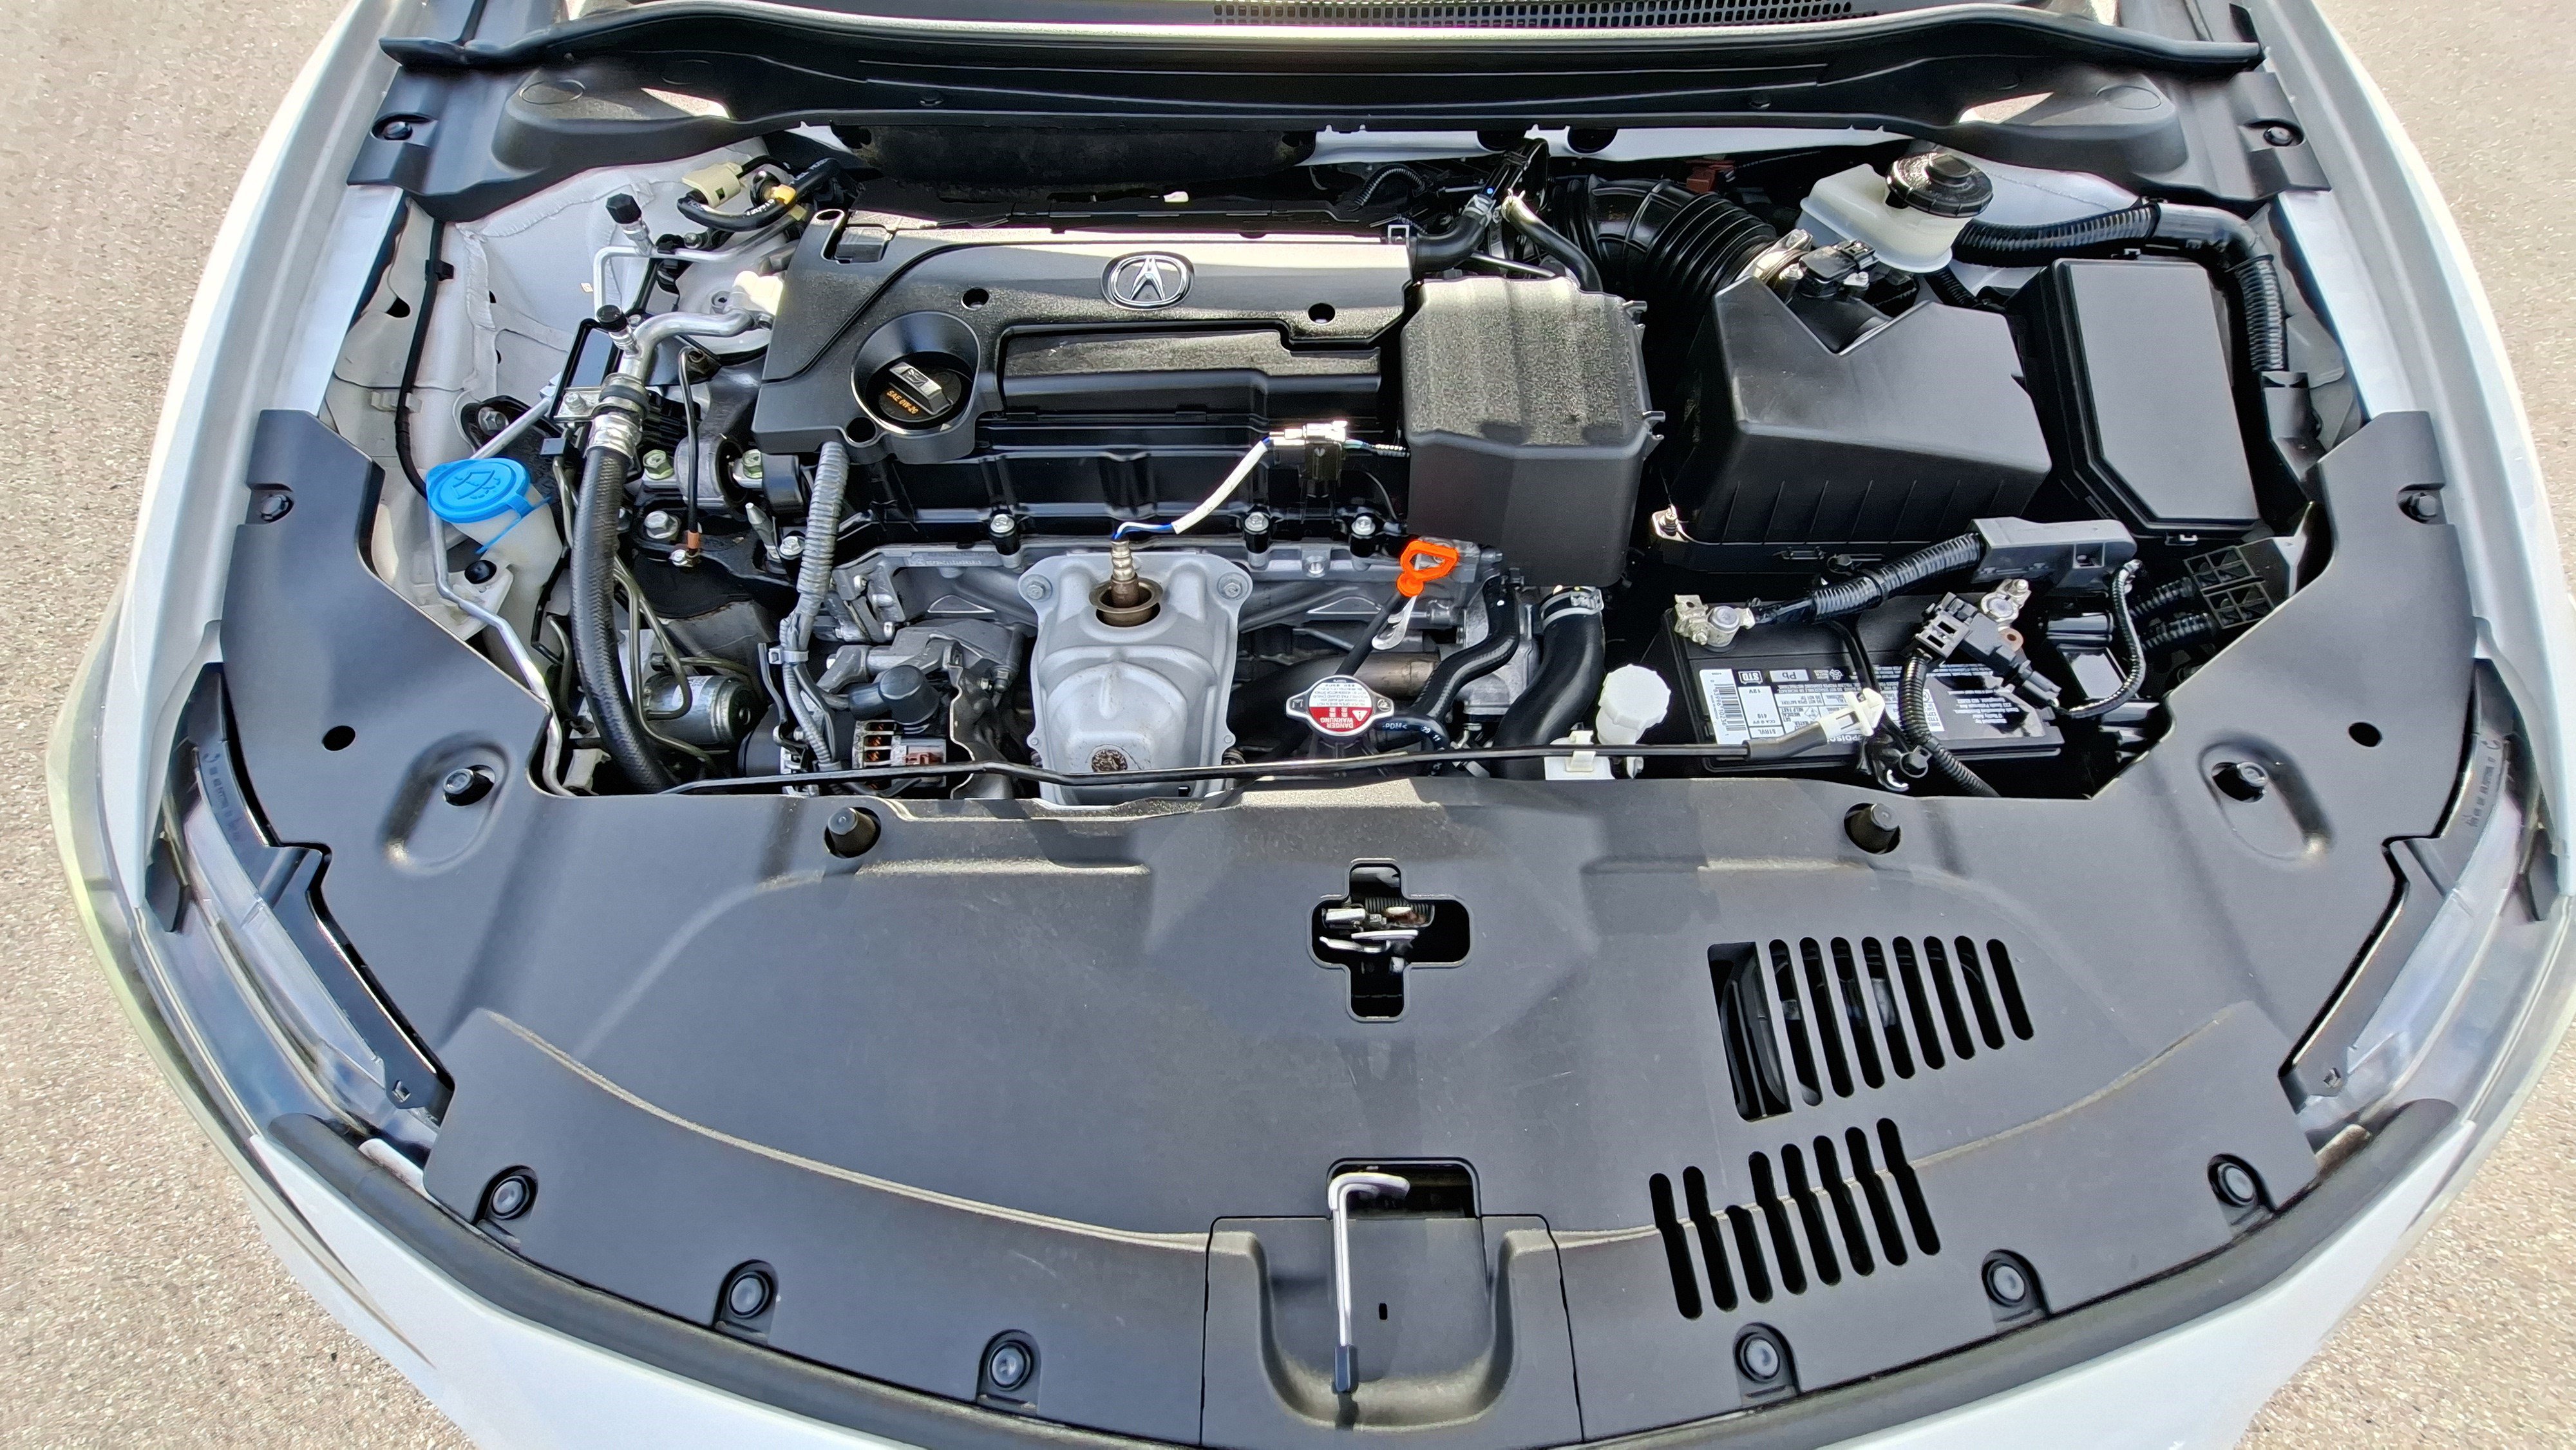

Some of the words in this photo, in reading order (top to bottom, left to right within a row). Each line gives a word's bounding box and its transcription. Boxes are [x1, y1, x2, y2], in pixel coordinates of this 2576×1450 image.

[886, 390, 902, 402] SAE
[898, 399, 919, 414] 0W-20
[1742, 672, 1759, 681] STD
